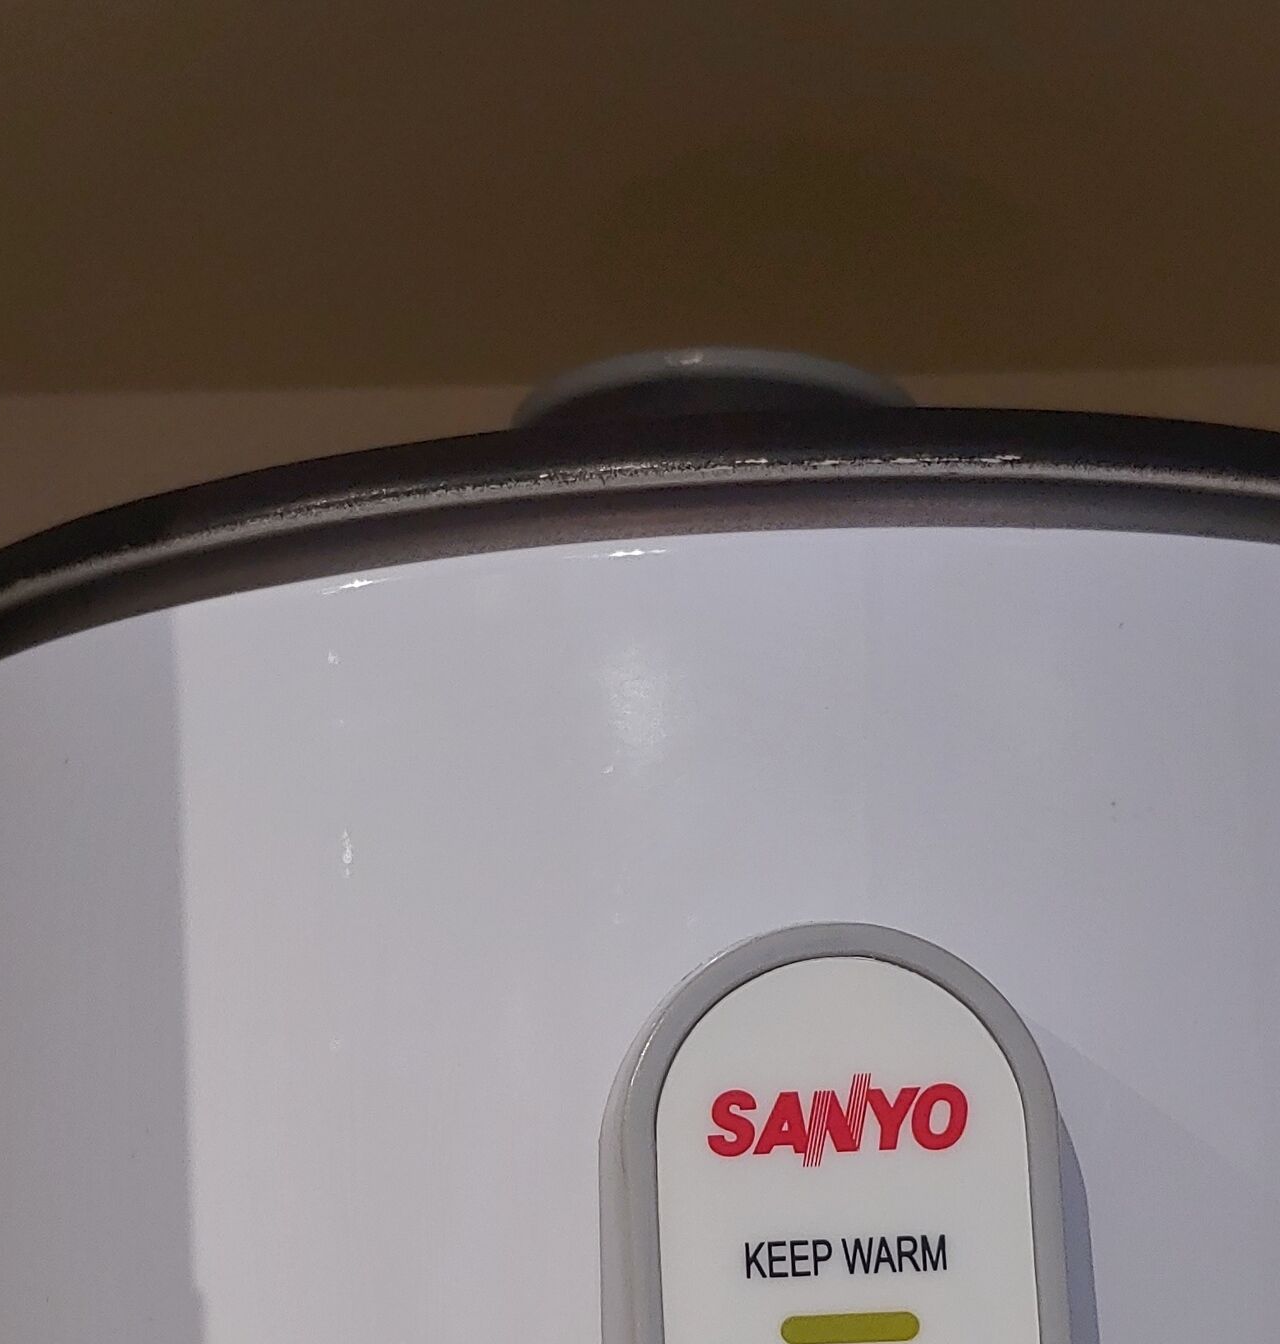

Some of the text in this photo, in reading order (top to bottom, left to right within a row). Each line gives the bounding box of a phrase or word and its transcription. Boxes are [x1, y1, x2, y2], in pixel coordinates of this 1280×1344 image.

[708, 1073, 968, 1167] SANYO
[745, 1235, 947, 1279] KEEP WARM
